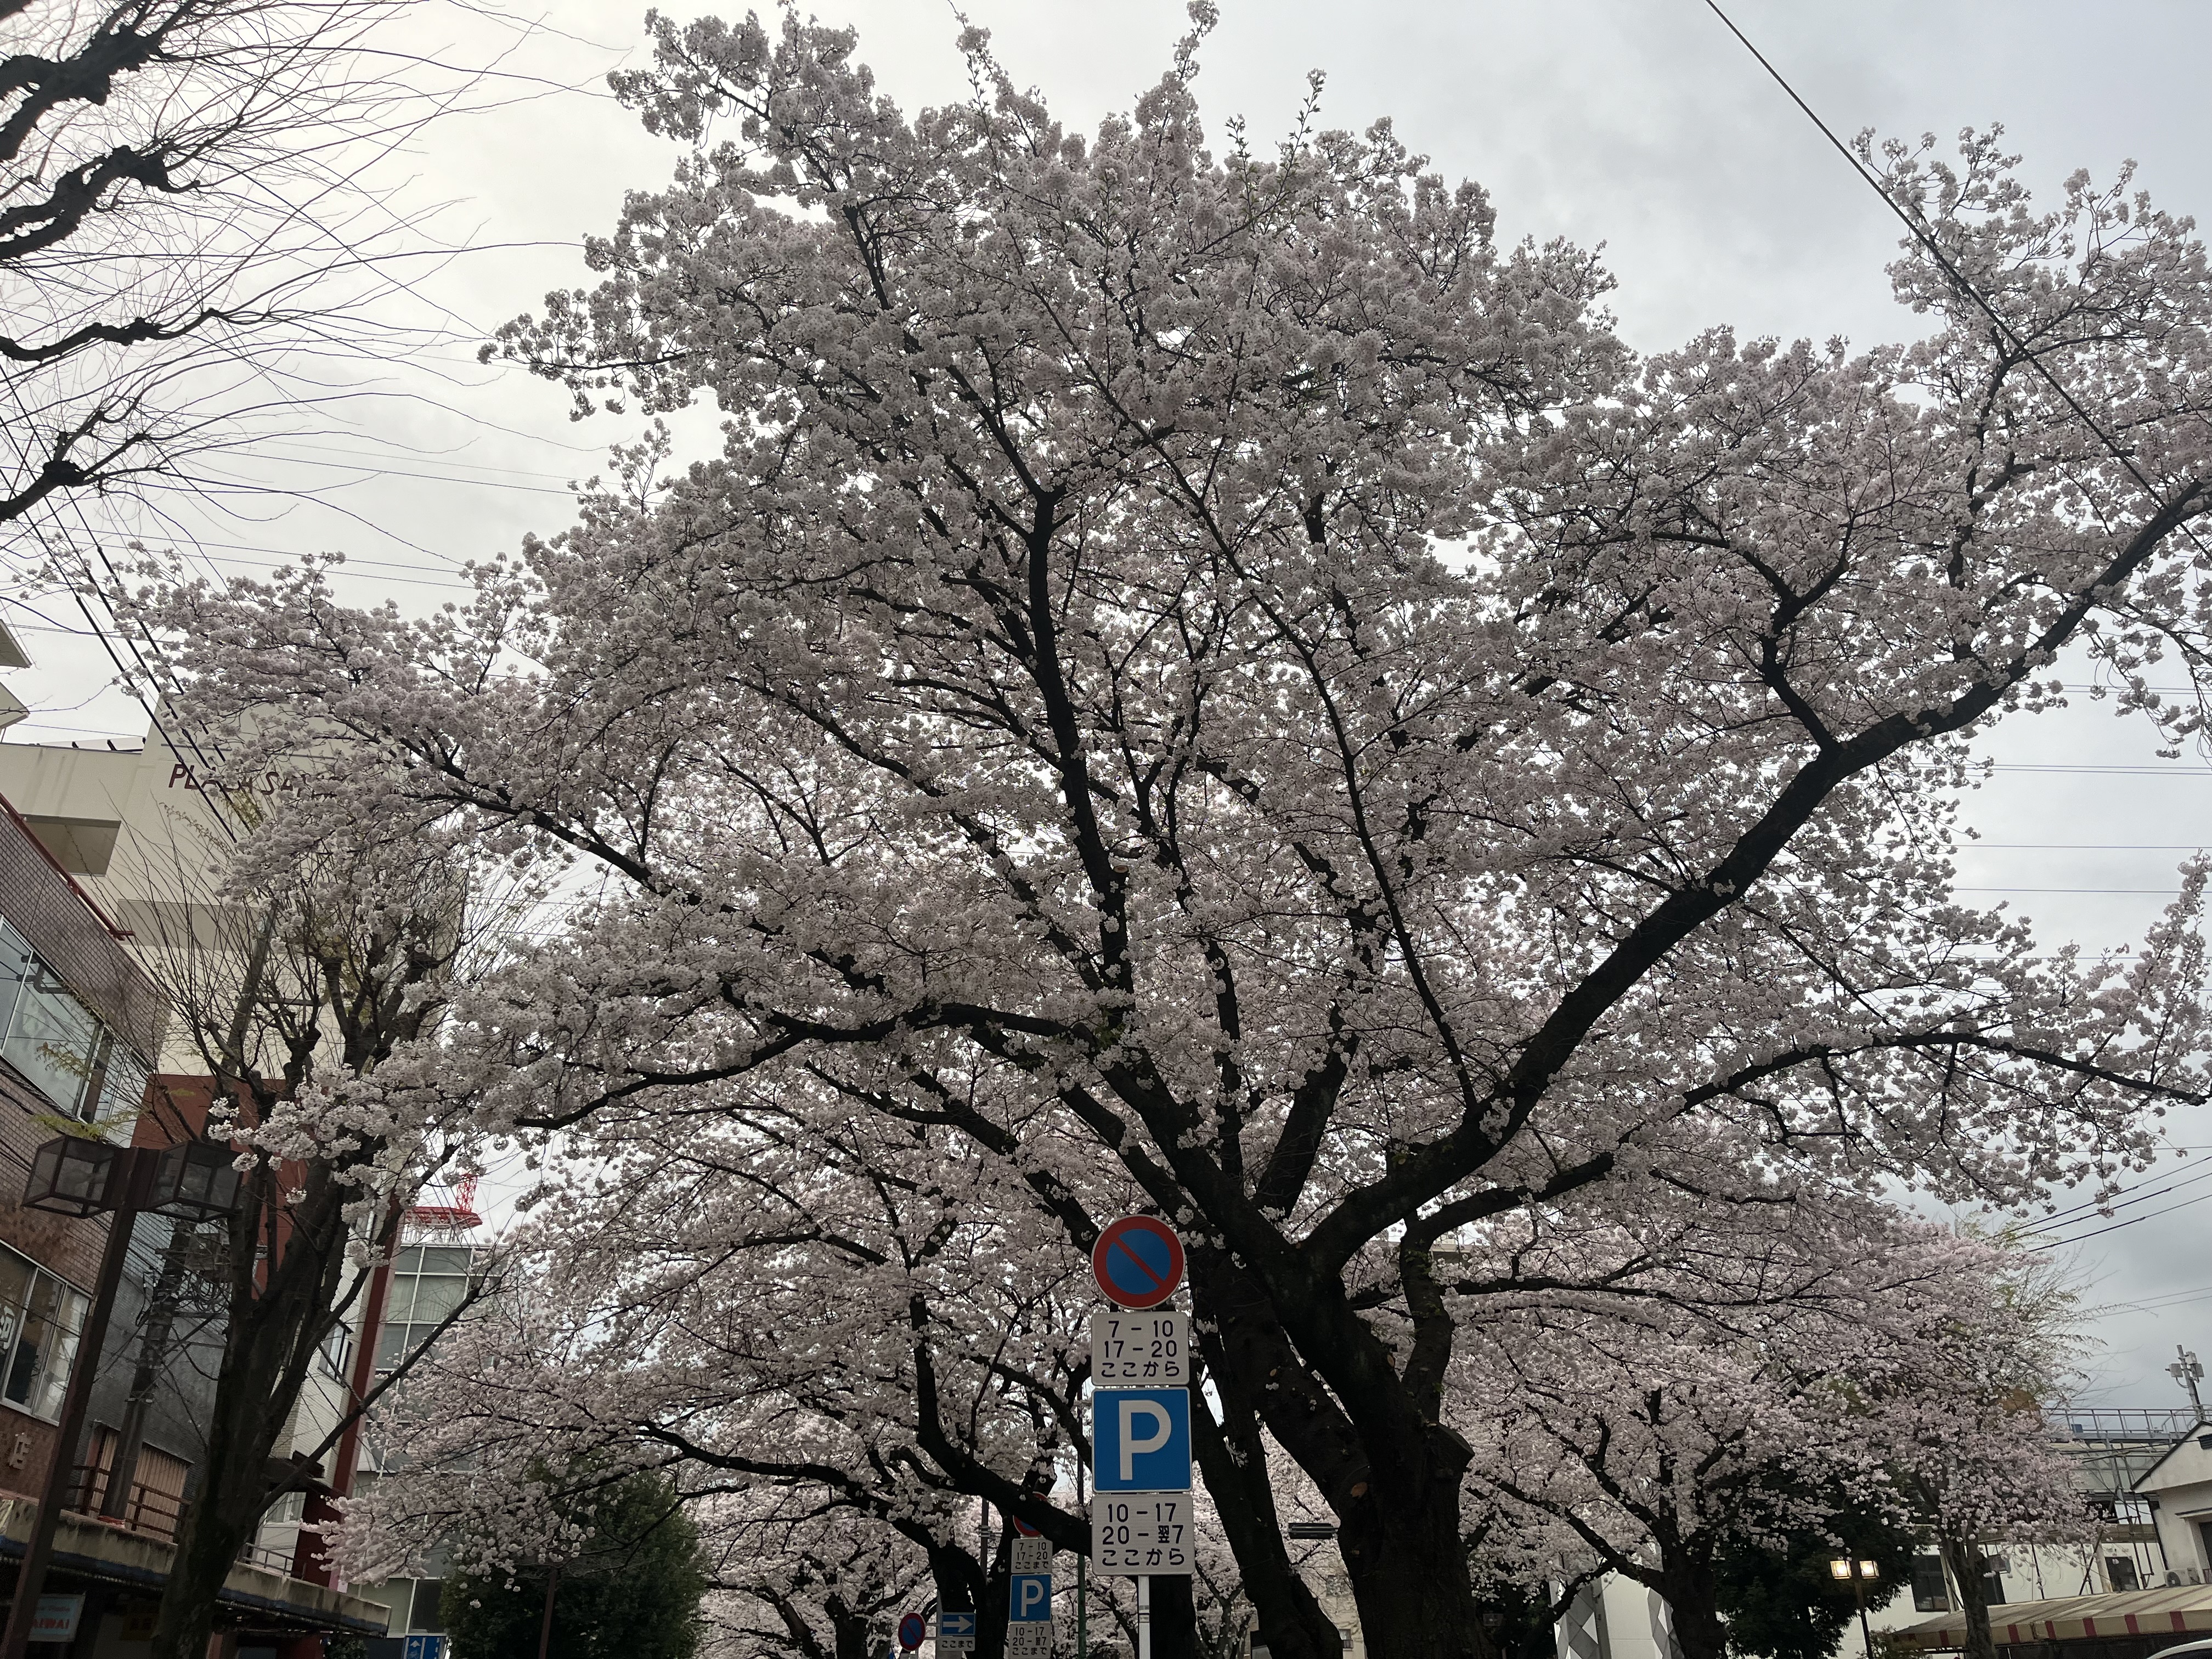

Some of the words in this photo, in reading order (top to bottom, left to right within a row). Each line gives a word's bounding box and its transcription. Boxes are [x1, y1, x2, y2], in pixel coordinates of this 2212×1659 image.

[1101, 1361, 1180, 1378] ここから
[1119, 1400, 1172, 1481] P
[1015, 1561, 1049, 1570] ここまで
[1102, 1548, 1185, 1566] ここから
[1021, 1579, 1044, 1617] P
[941, 1640, 973, 1649] ここまで
[1012, 1647, 1047, 1656] ここまで
